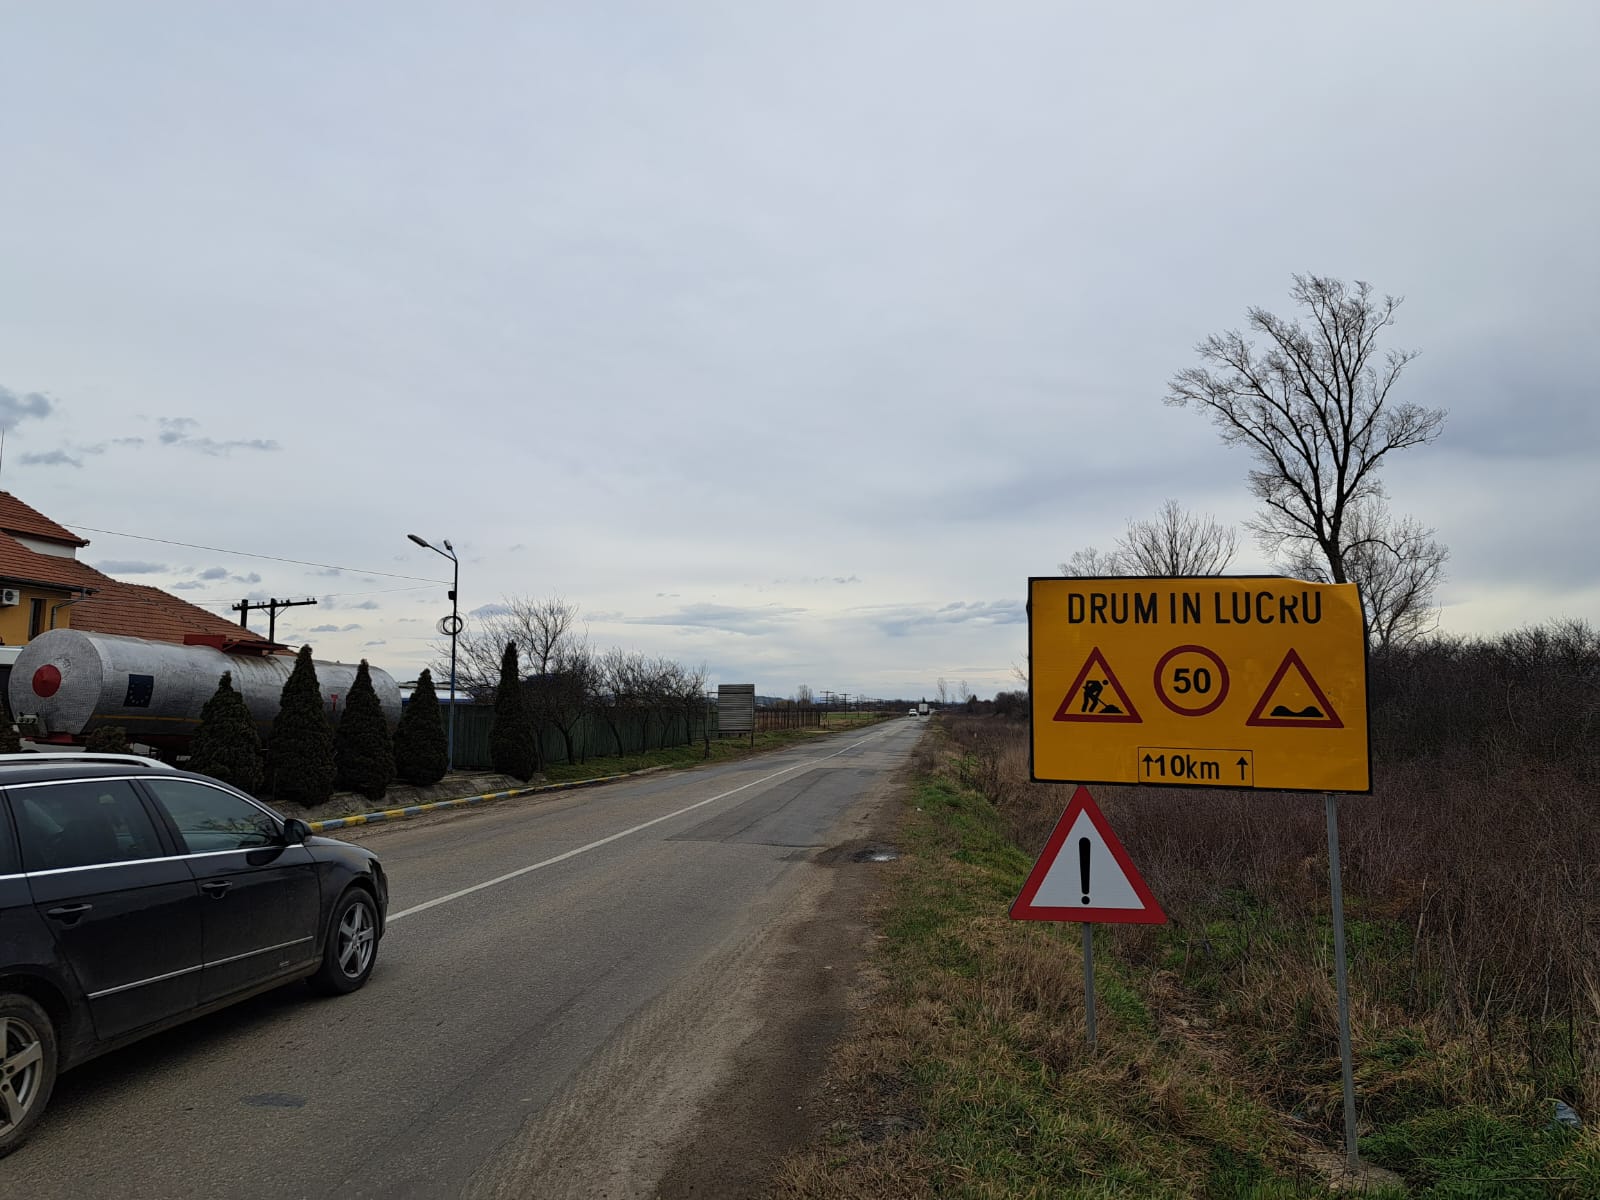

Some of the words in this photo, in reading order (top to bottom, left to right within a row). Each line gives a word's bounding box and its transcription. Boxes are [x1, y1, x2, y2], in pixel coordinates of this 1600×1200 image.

[1068, 592, 1158, 624] DRUM
[1170, 592, 1201, 624] IN
[1214, 591, 1322, 624] LUCRU
[1173, 668, 1211, 694] 50
[1154, 754, 1220, 780] 10km
